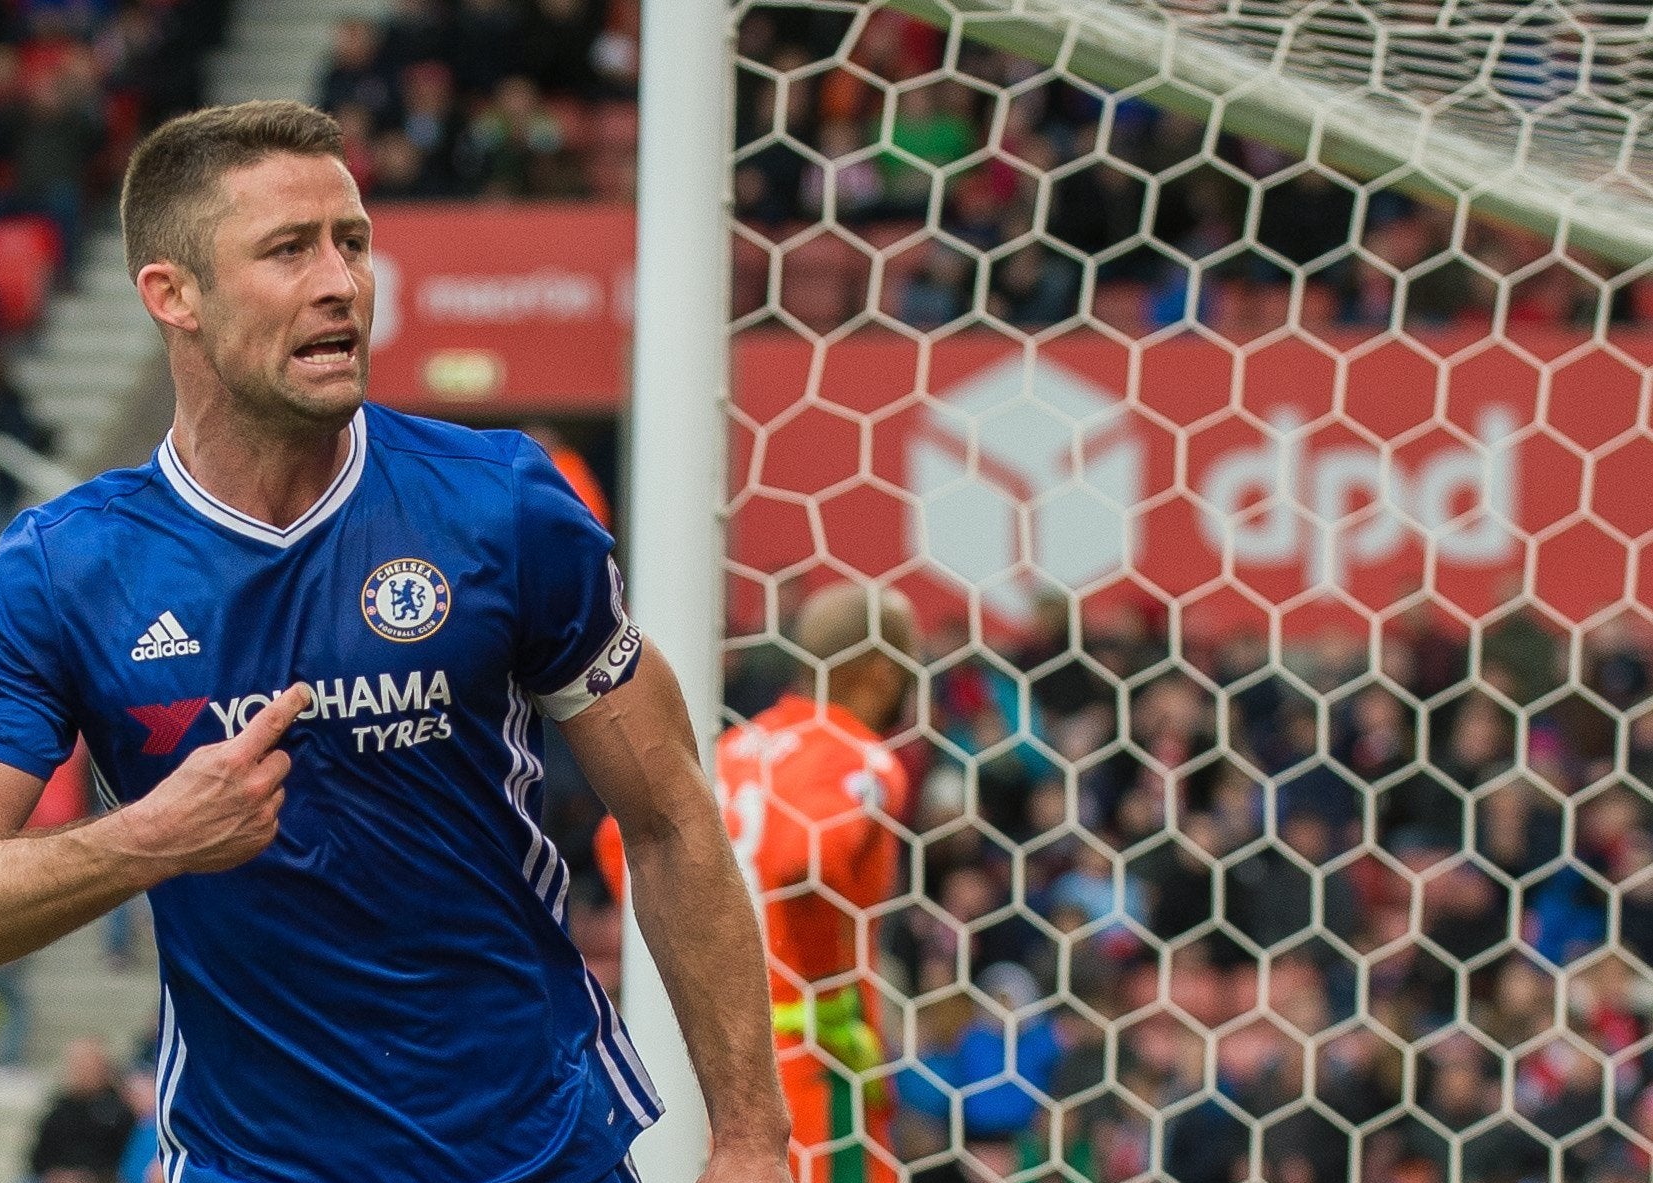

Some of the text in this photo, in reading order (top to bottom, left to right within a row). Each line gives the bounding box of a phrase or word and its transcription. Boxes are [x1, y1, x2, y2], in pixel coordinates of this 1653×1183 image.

[1199, 404, 1524, 590] dpd
[376, 562, 433, 582] CHELSEA
[130, 638, 201, 662] adidas
[209, 670, 452, 740] YOHAMA
[352, 712, 452, 753] TYRES
